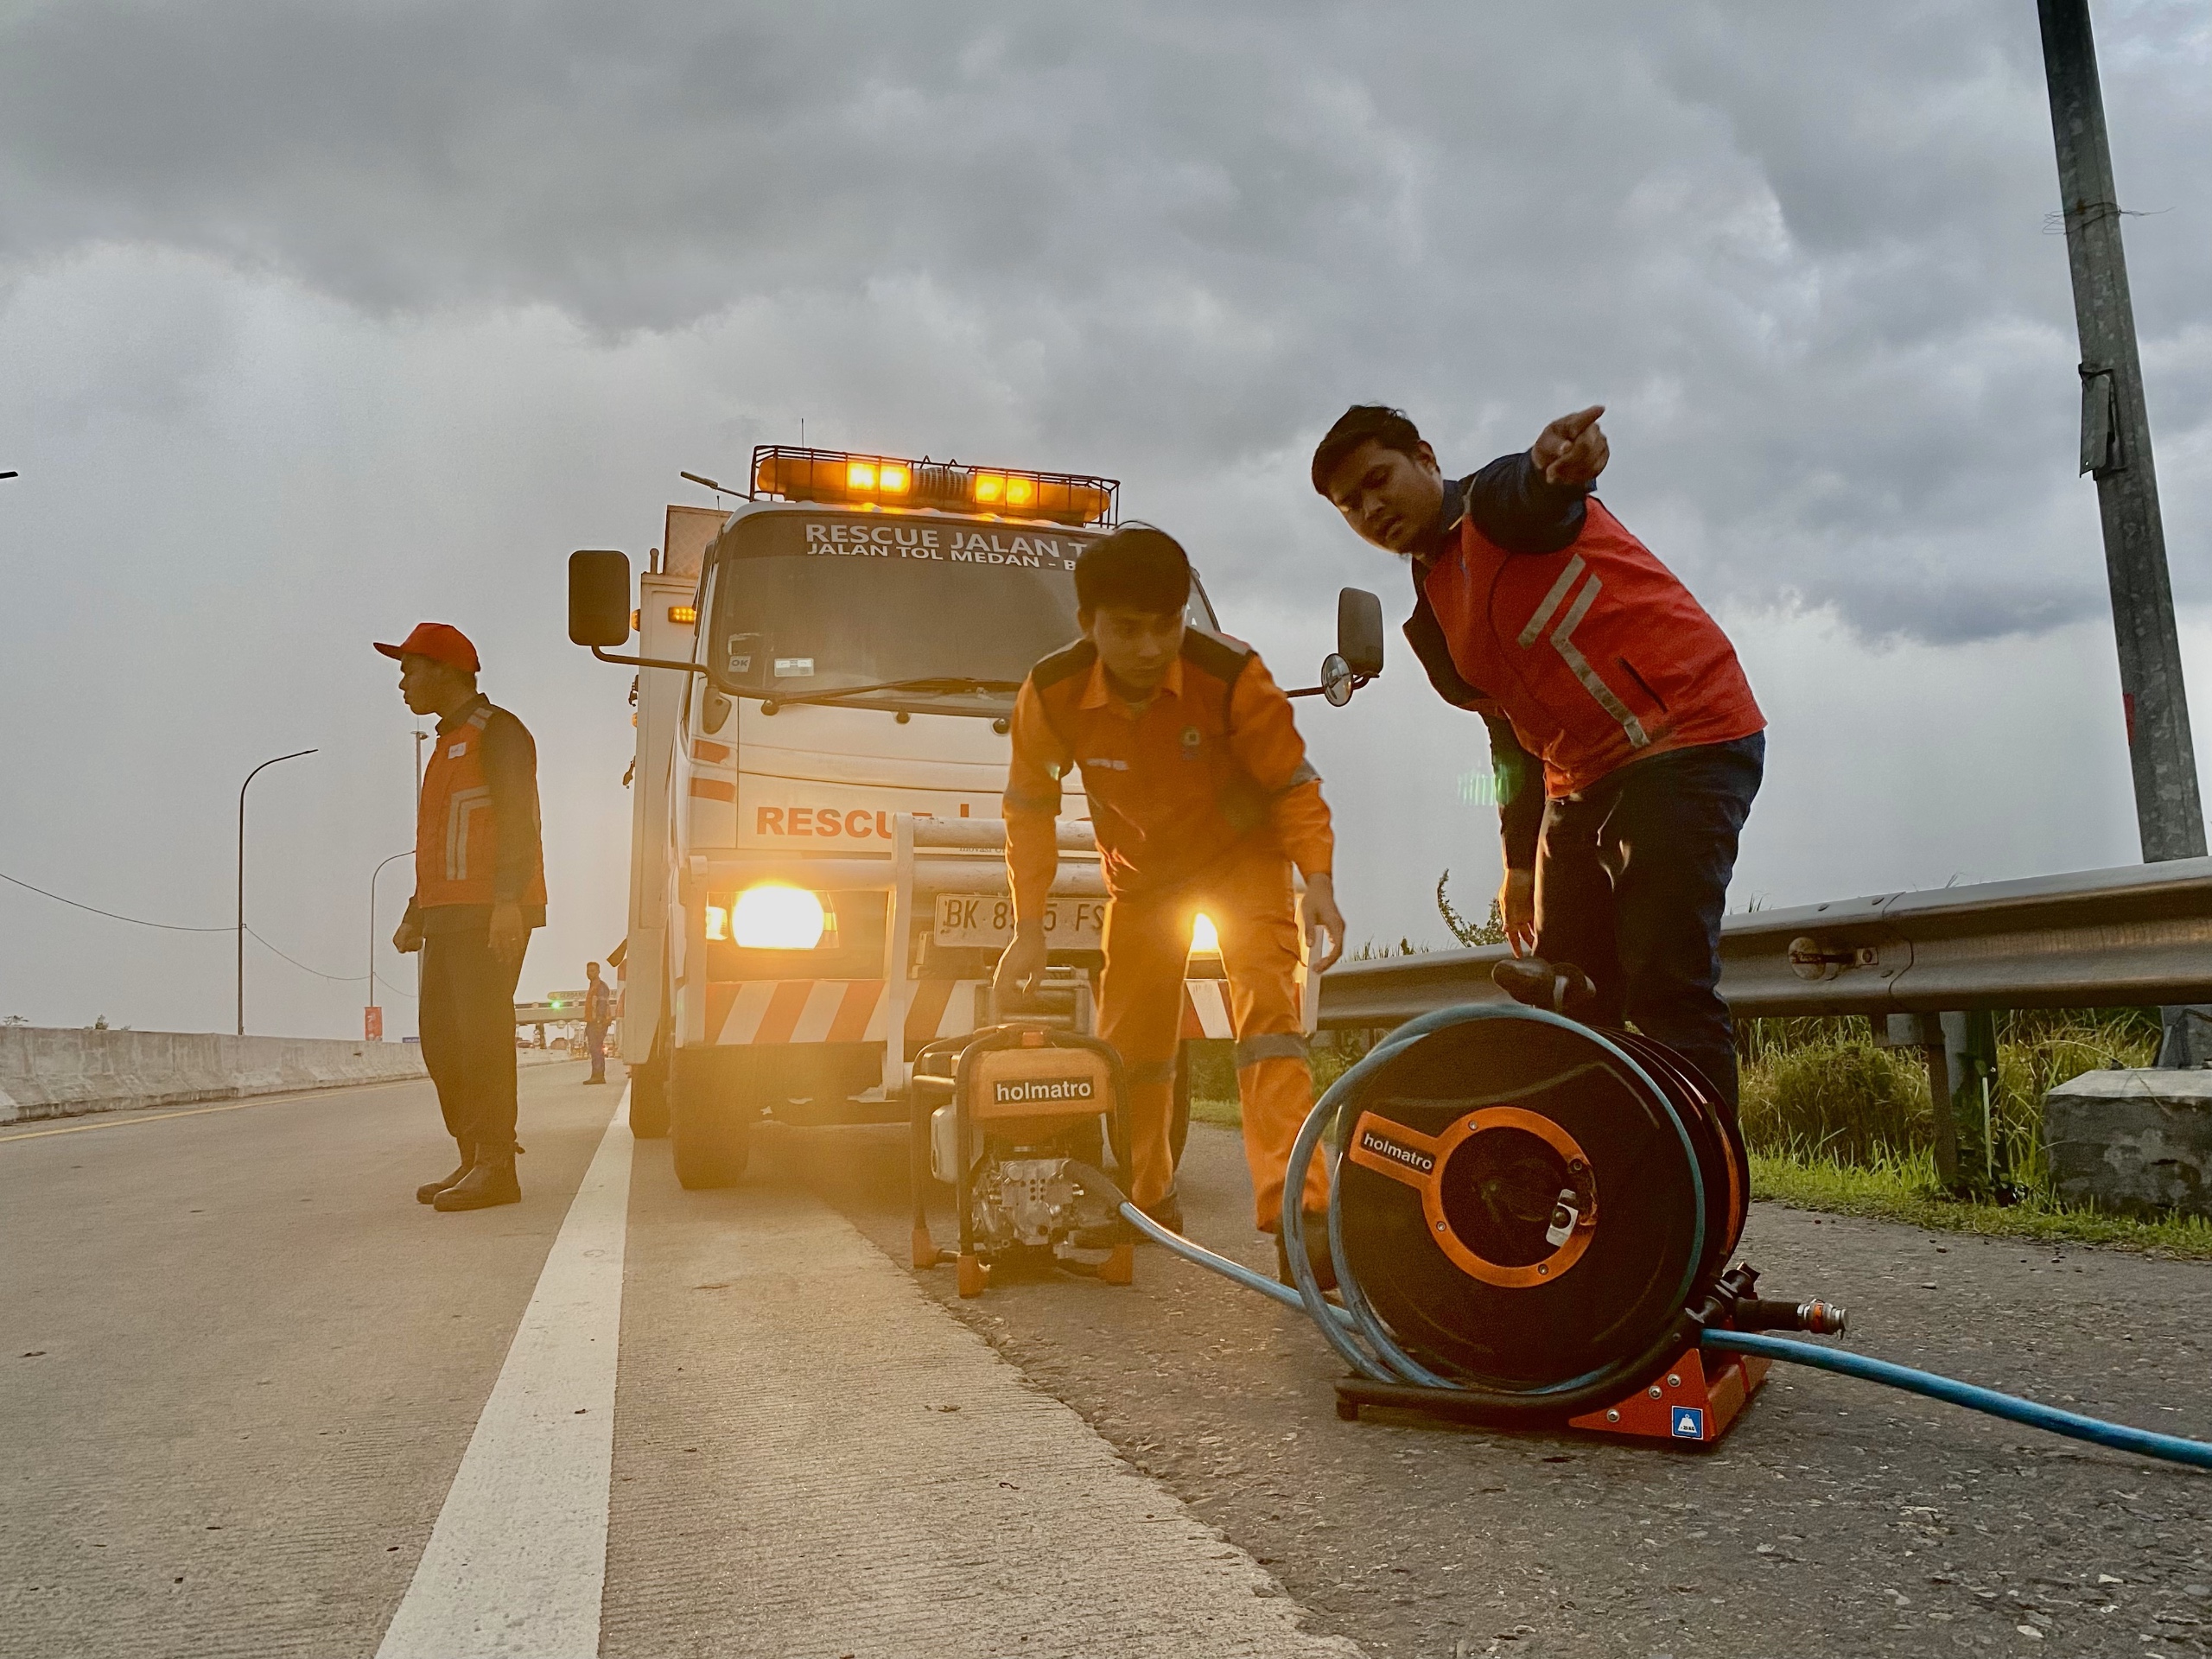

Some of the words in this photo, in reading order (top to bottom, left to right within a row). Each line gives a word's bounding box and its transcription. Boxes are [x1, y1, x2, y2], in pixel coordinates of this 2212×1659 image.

[805, 524, 940, 548] RESCUE
[950, 532, 1059, 558] JALAN
[807, 543, 888, 557] JALAN
[895, 546, 944, 561] TOL
[950, 550, 1040, 568] MEDAN
[757, 806, 932, 840] RESCU
[946, 899, 980, 930] BK
[993, 901, 1057, 931] 85
[996, 1080, 1091, 1102] holmatro
[1363, 1133, 1433, 1170] holmatro
